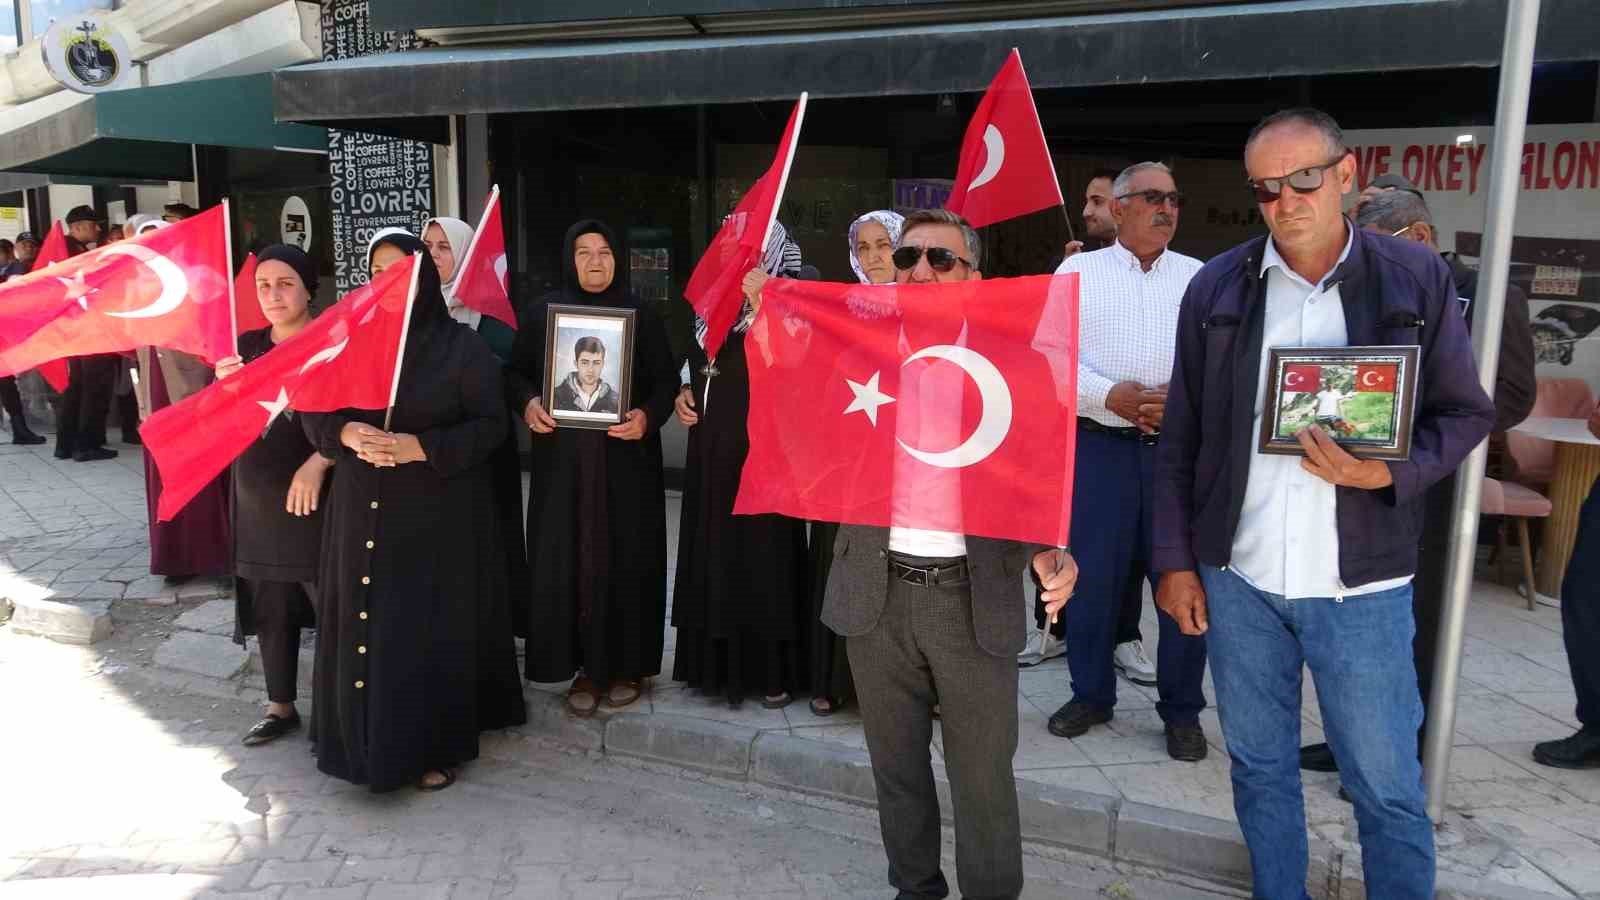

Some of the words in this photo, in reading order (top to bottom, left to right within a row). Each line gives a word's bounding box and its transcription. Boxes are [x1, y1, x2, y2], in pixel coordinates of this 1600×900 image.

[344, 135, 357, 191] COFFEE
[355, 143, 387, 157] COFFEE
[356, 155, 389, 166] LOVREN
[328, 132, 345, 214] LOVREN
[365, 166, 398, 178] COFFEE
[403, 139, 415, 189] COFFEE
[1355, 146, 1391, 193] VE
[1402, 144, 1486, 195] OKEY
[365, 177, 404, 190] LOVREN
[350, 188, 431, 215] LOVREN
[353, 216, 387, 227] LOVREN
[387, 215, 411, 225] COFFEE
[332, 214, 345, 261] COFFEE
